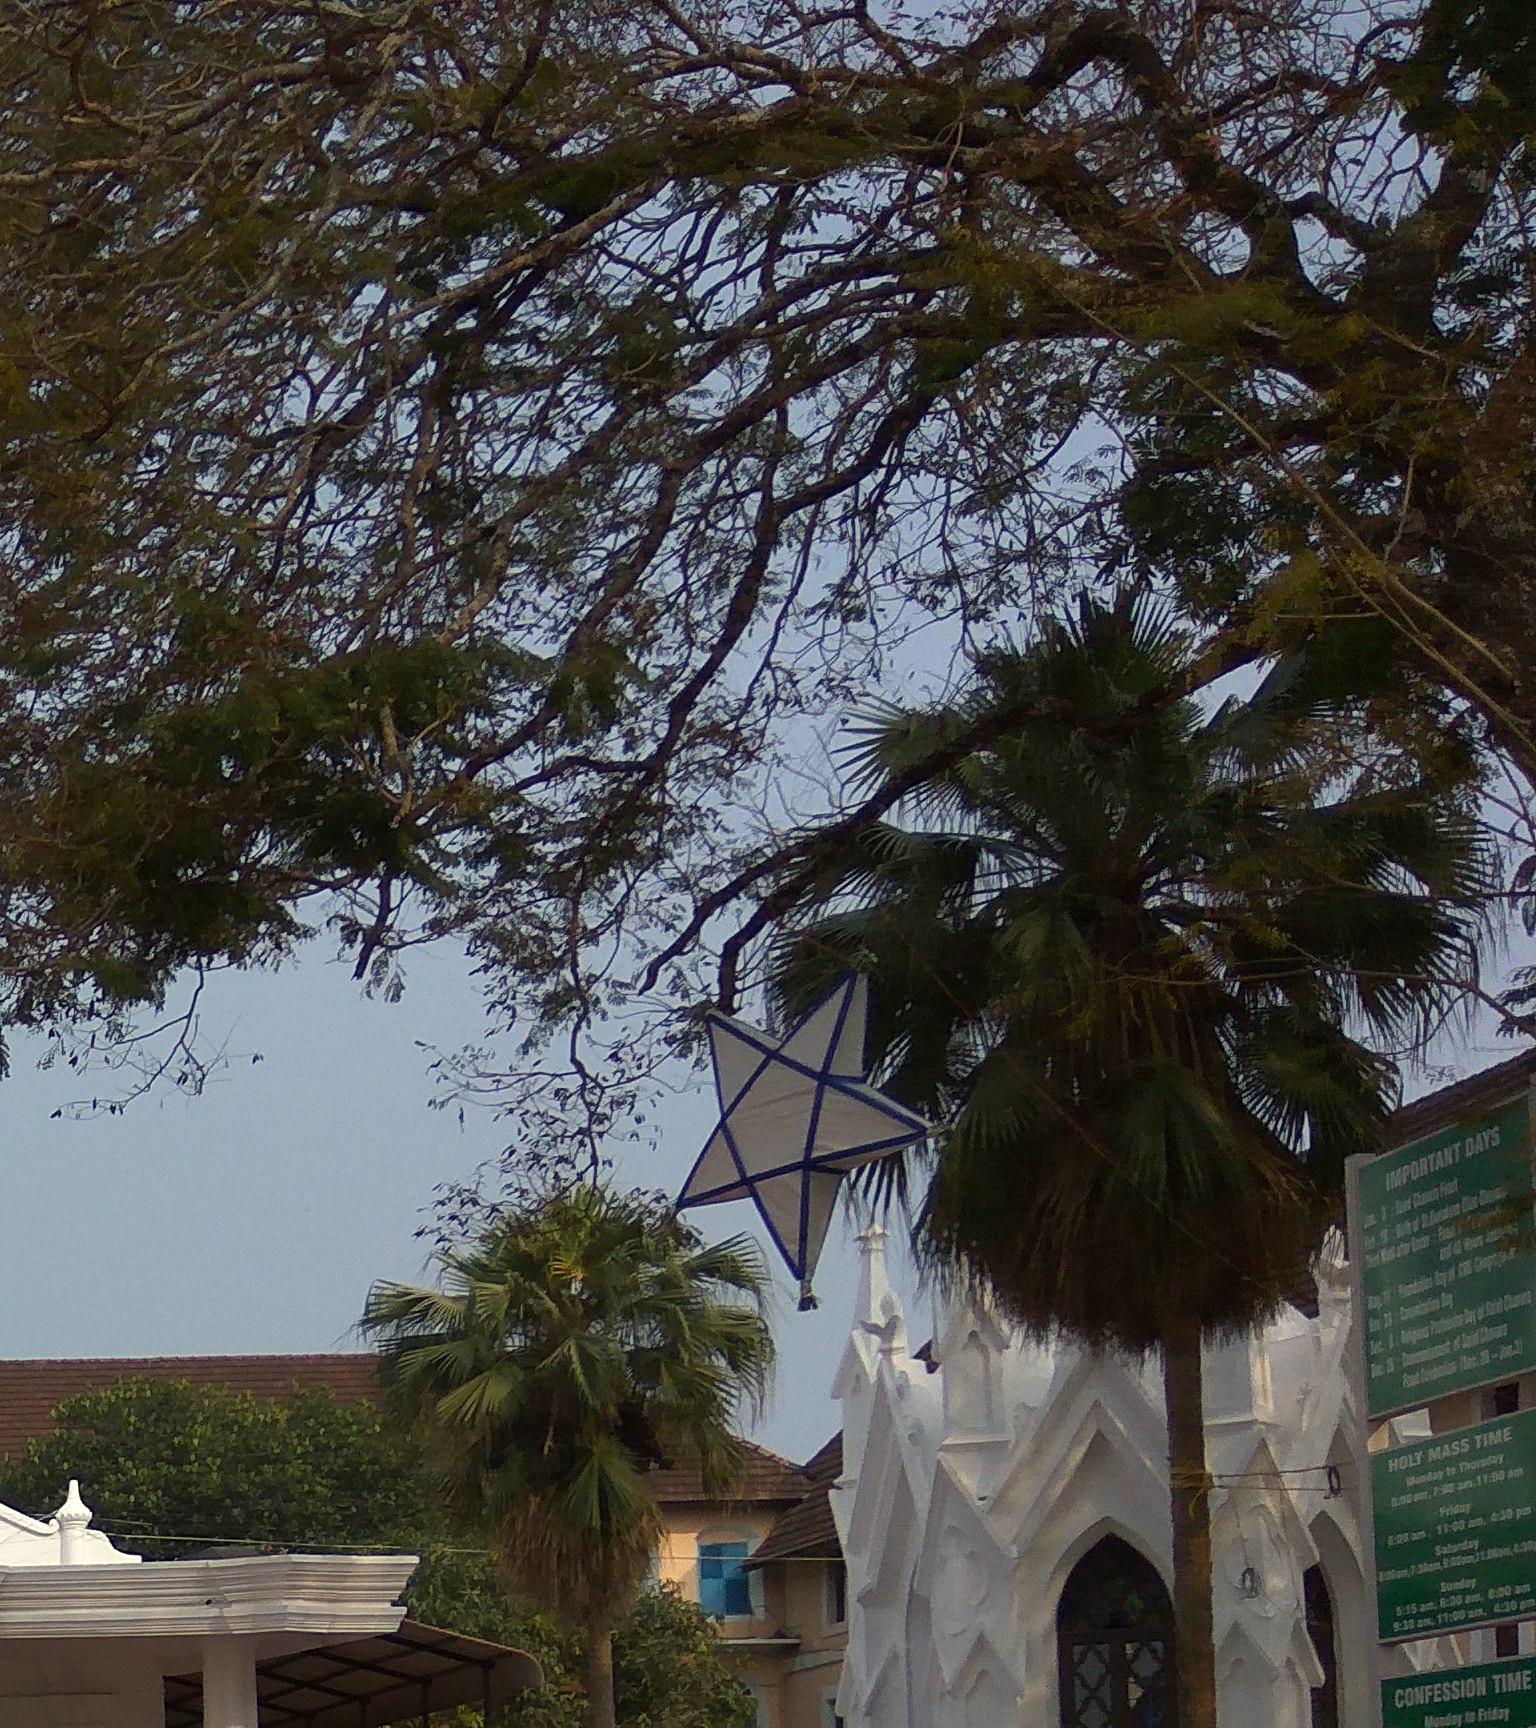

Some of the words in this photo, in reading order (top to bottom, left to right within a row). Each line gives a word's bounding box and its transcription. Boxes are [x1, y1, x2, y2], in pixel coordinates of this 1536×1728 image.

[1386, 1142, 1462, 1192] IMPORTANT
[1465, 1126, 1501, 1158] DAYS
[1387, 1451, 1423, 1473] HOLY
[1428, 1438, 1470, 1462] MASS
[1474, 1427, 1512, 1448] TIME
[1435, 1539, 1479, 1556] Saturday
[1394, 1677, 1487, 1708] CONFESSION
[1491, 1669, 1533, 1694] TIME
[1424, 1713, 1463, 1728] Monday
[1465, 1711, 1476, 1723] to
[1478, 1707, 1510, 1722] Friday
